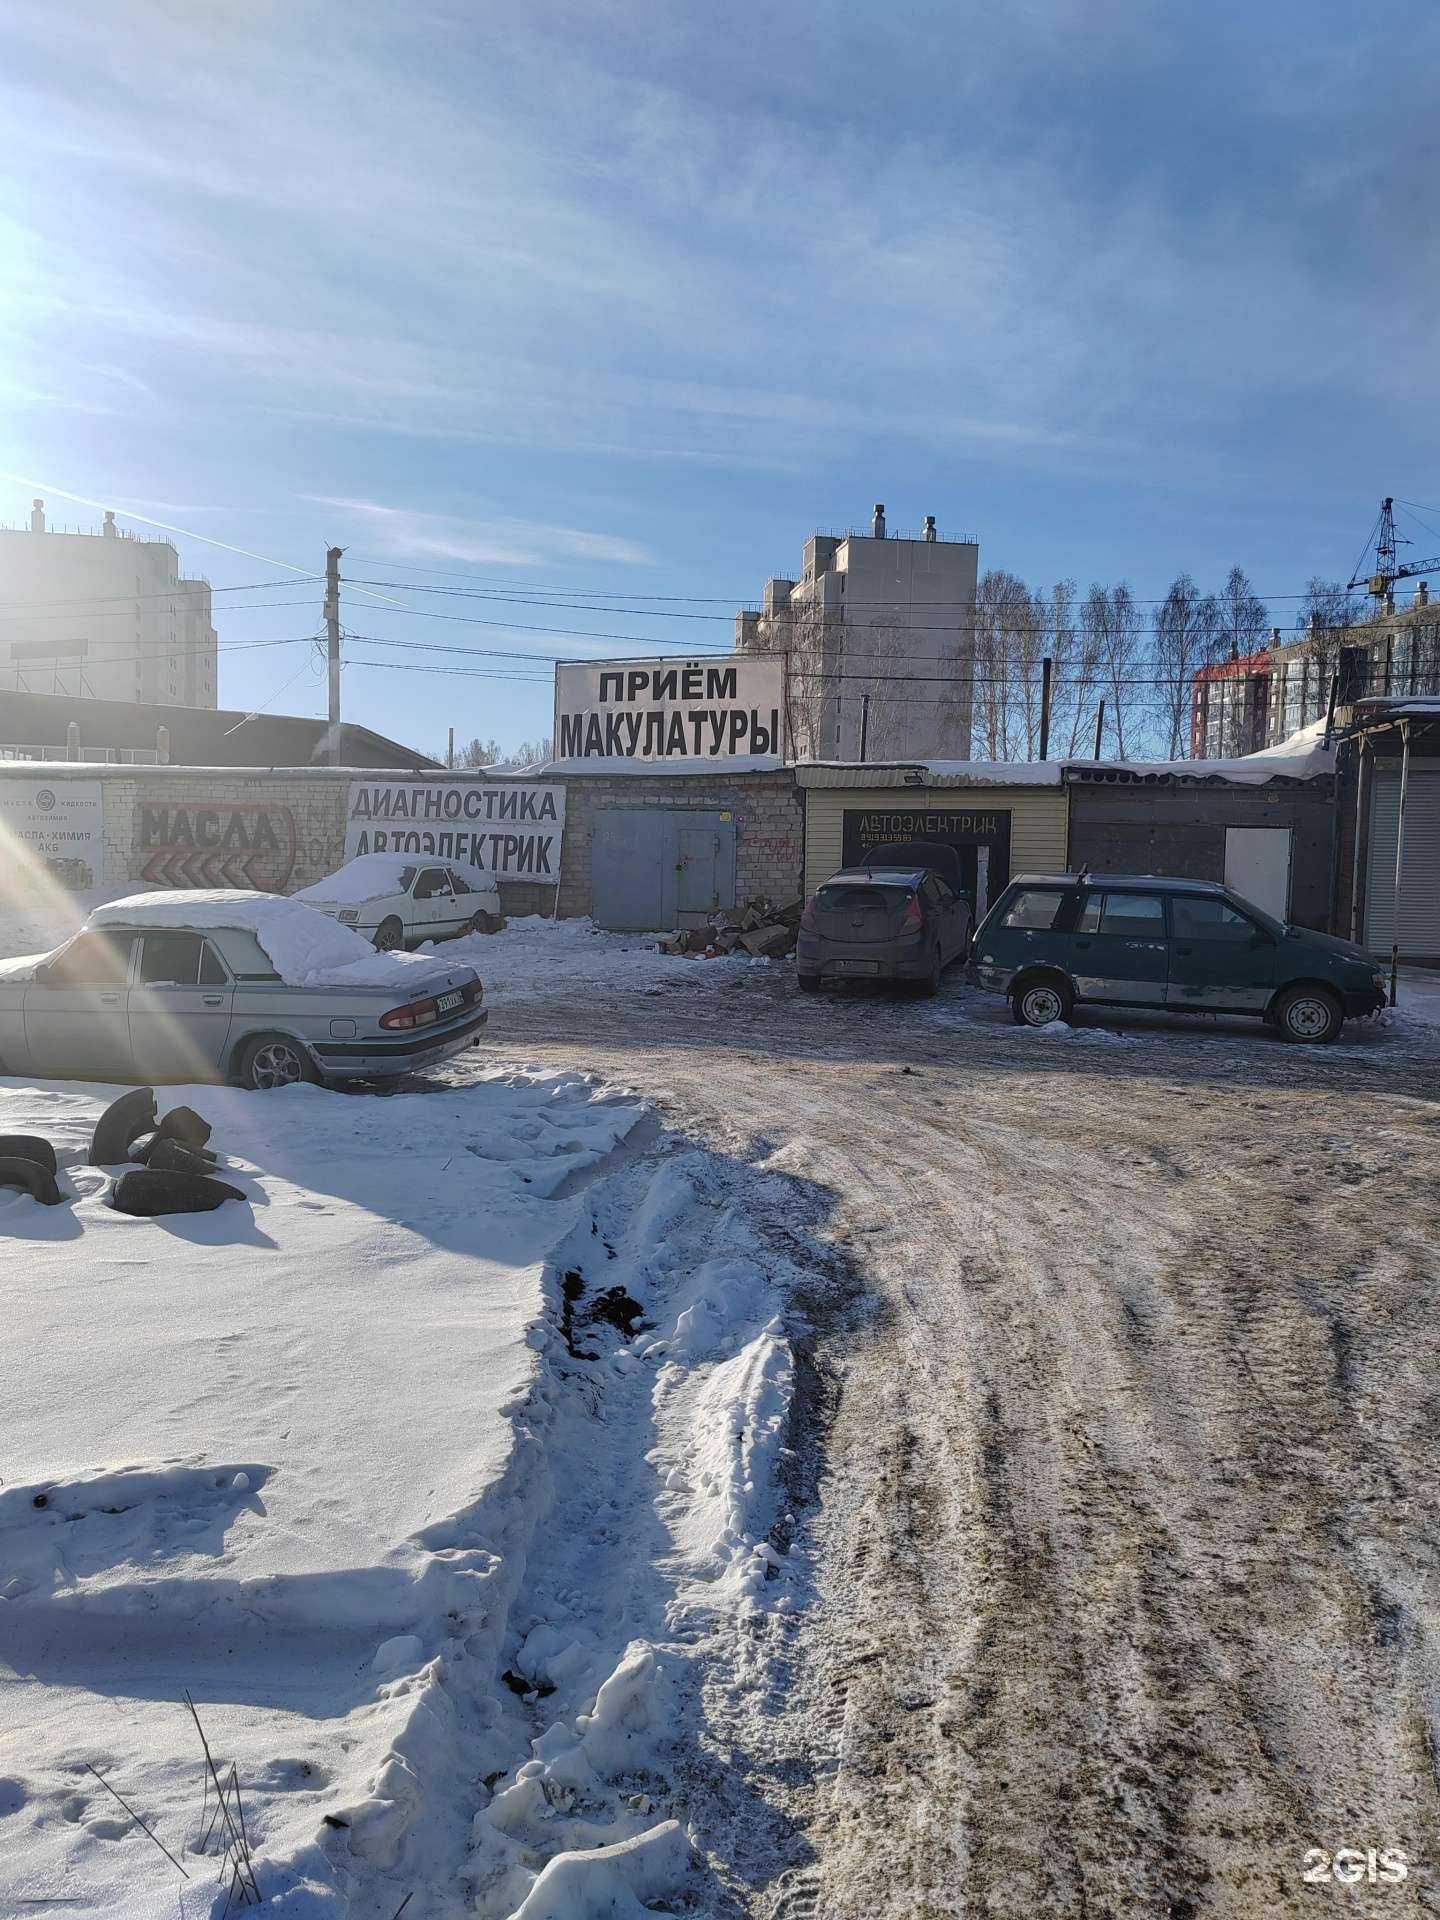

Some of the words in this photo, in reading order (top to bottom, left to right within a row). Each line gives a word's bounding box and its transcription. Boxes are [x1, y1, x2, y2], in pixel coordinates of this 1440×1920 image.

[599, 663, 736, 702] ПРИЁМ
[561, 709, 778, 757] МАКУЛАТУРЫ
[352, 787, 557, 821] ДИАГНОСТИКА
[52, 832, 91, 840] ХИМИЯ
[141, 809, 279, 849] МАСЛА
[859, 815, 997, 833] АВТОЭЛЕКТРИК
[38, 843, 59, 852] АКБ
